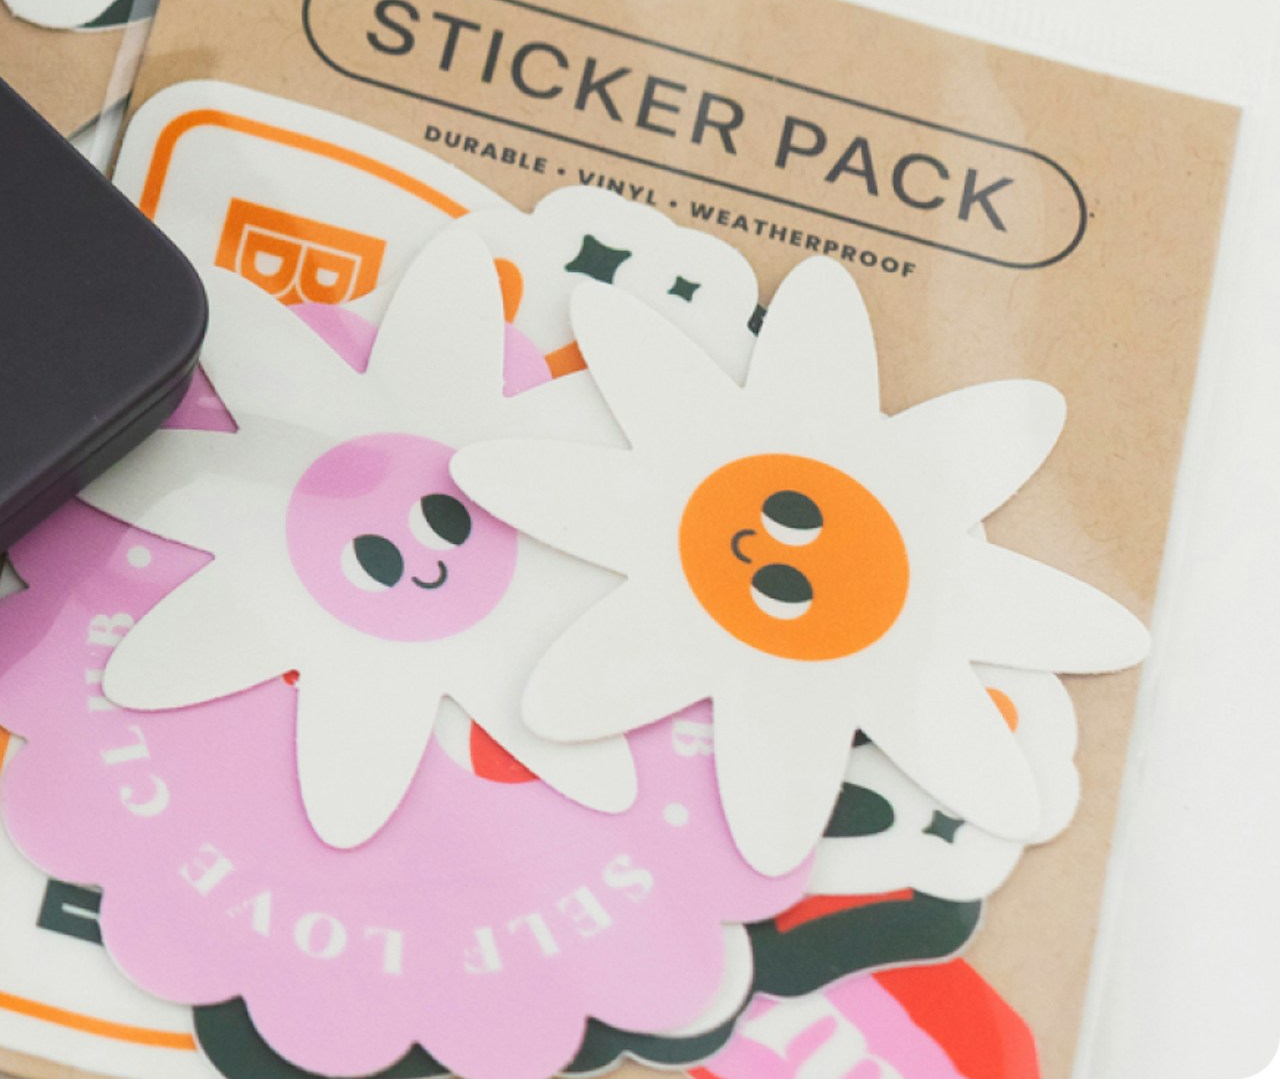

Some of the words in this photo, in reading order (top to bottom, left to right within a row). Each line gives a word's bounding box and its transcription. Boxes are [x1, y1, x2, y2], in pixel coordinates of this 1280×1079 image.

[424, 124, 549, 175] DURABLE
[578, 168, 658, 206] VINYL
[689, 201, 917, 278] WEATHERPROOF
[773, 114, 1017, 233] PACK
[177, 841, 405, 976] LOVE
[463, 852, 655, 976] SELF
